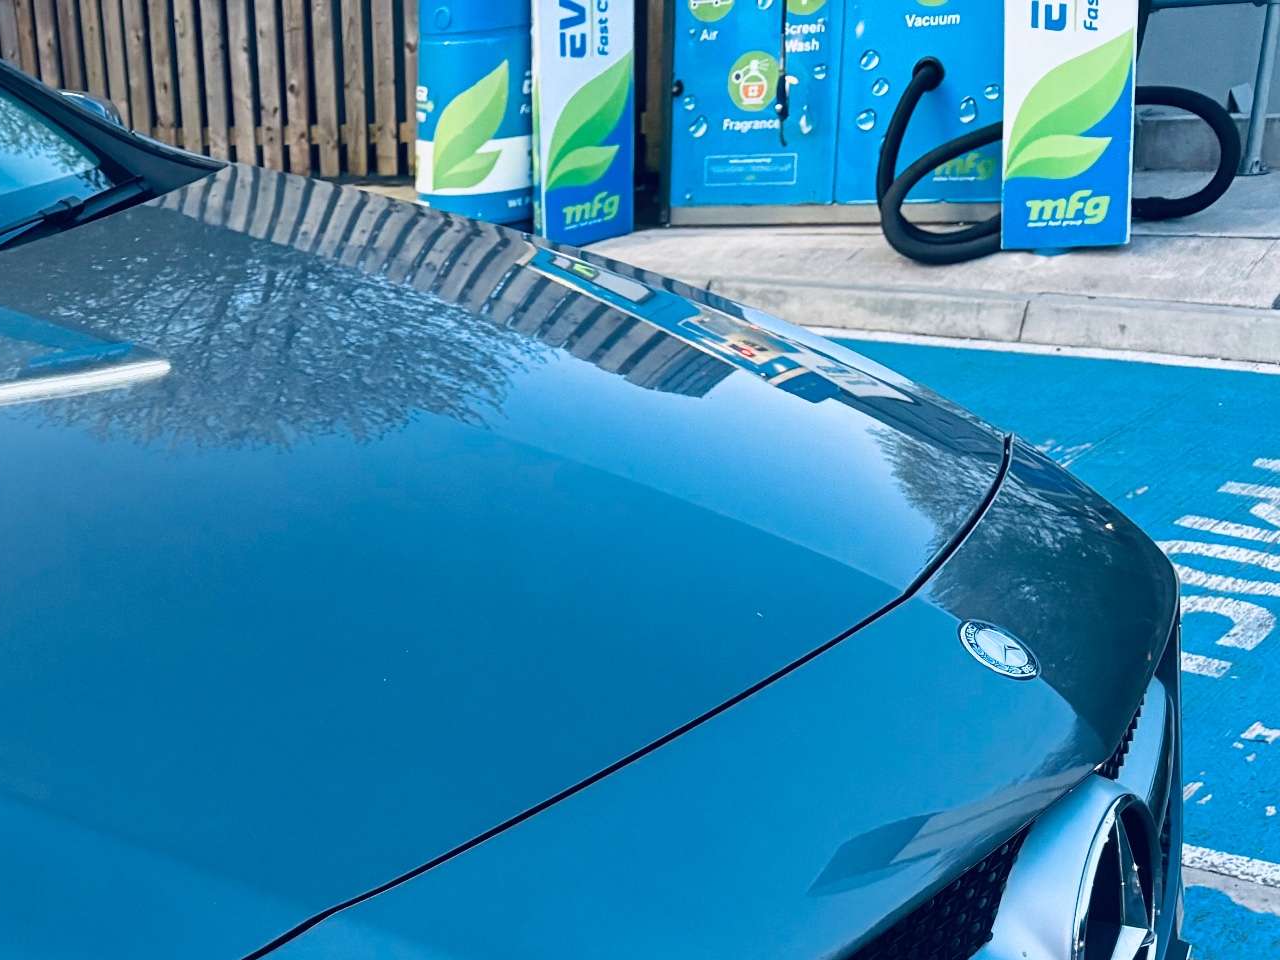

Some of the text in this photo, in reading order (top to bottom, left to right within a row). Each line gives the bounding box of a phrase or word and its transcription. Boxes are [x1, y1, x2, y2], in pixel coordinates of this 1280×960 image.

[904, 13, 961, 28] Vacuum
[699, 28, 719, 42] Air
[784, 38, 821, 53] Wash
[562, 191, 621, 225] mfg
[1025, 189, 1111, 225] mfg
